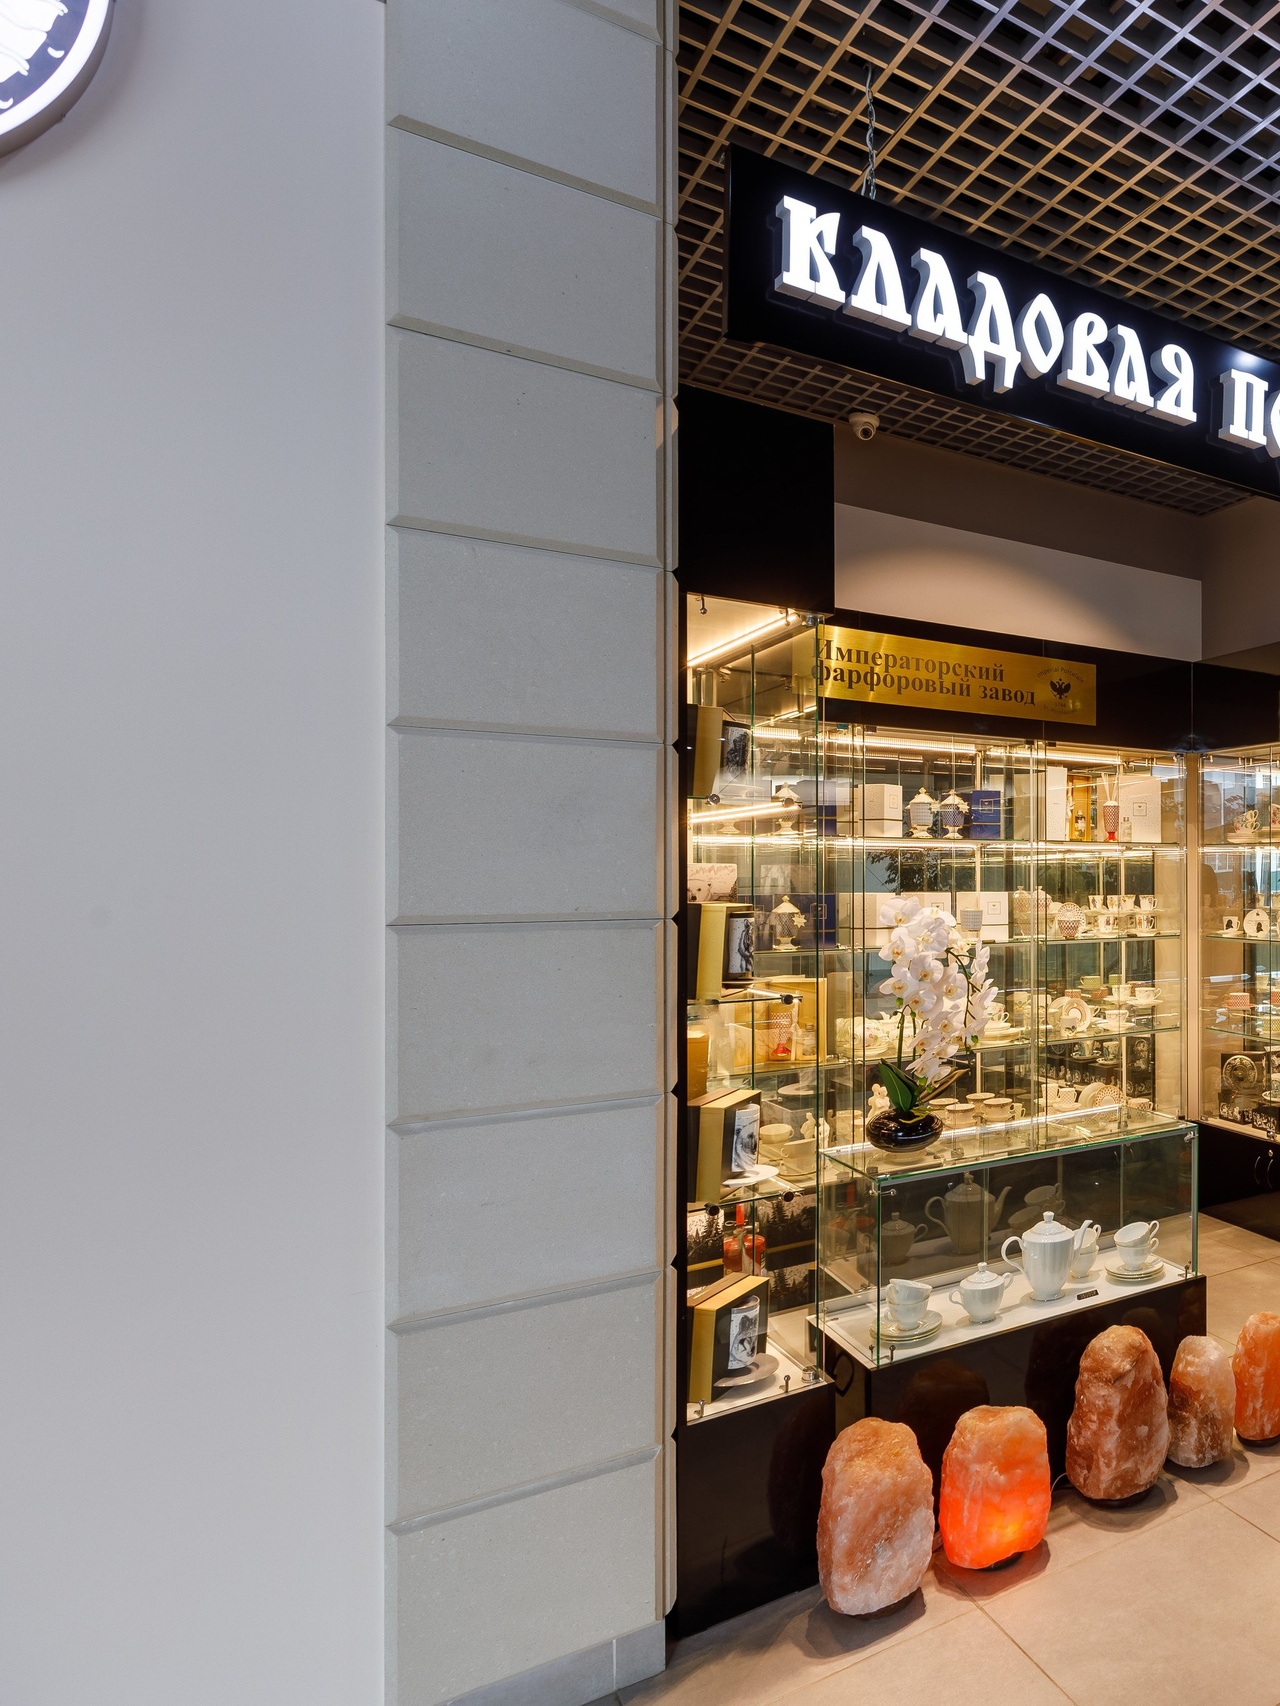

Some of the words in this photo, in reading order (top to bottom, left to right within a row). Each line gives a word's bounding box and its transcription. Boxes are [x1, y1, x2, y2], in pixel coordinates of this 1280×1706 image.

[776, 195, 1198, 426] КЛАДОВАЯ
[811, 659, 972, 698] фарфоровый
[978, 685, 1036, 707] завод
[812, 637, 1005, 683] Императорский
